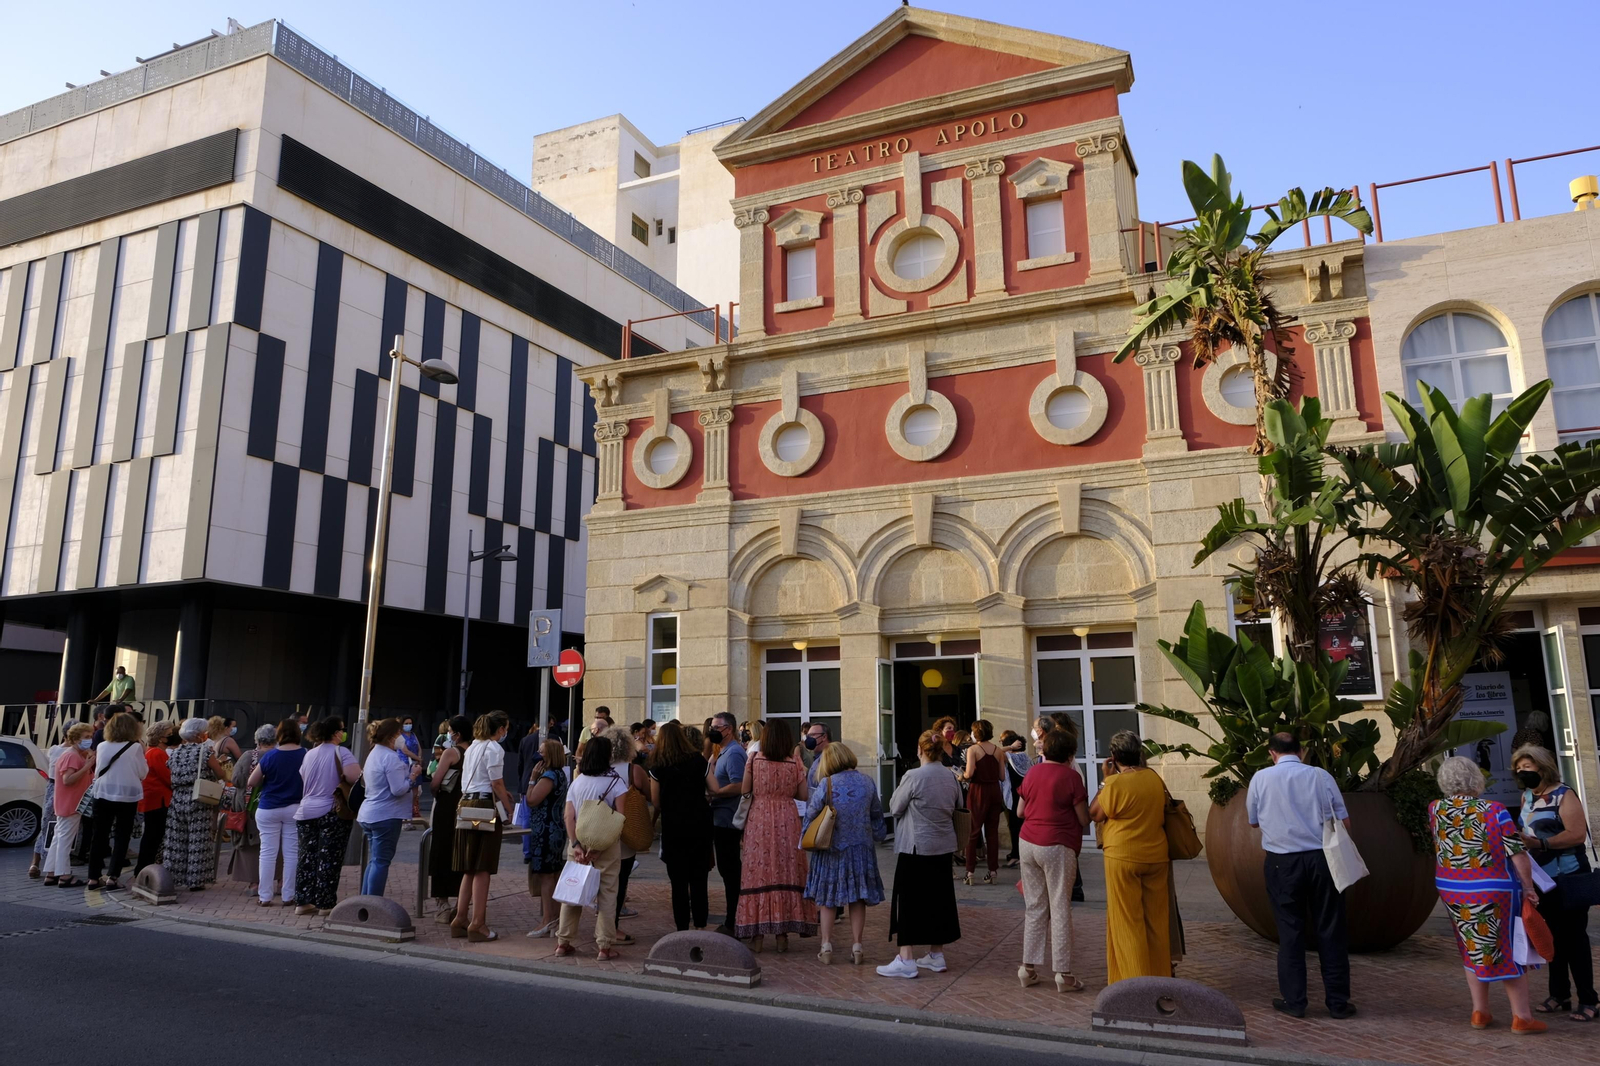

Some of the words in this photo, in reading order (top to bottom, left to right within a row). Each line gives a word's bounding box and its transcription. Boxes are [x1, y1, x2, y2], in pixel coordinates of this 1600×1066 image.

[810, 137, 909, 173] TEATRO
[935, 112, 1024, 146] APOLO
[533, 616, 552, 647] P
[1476, 691, 1486, 699] los
